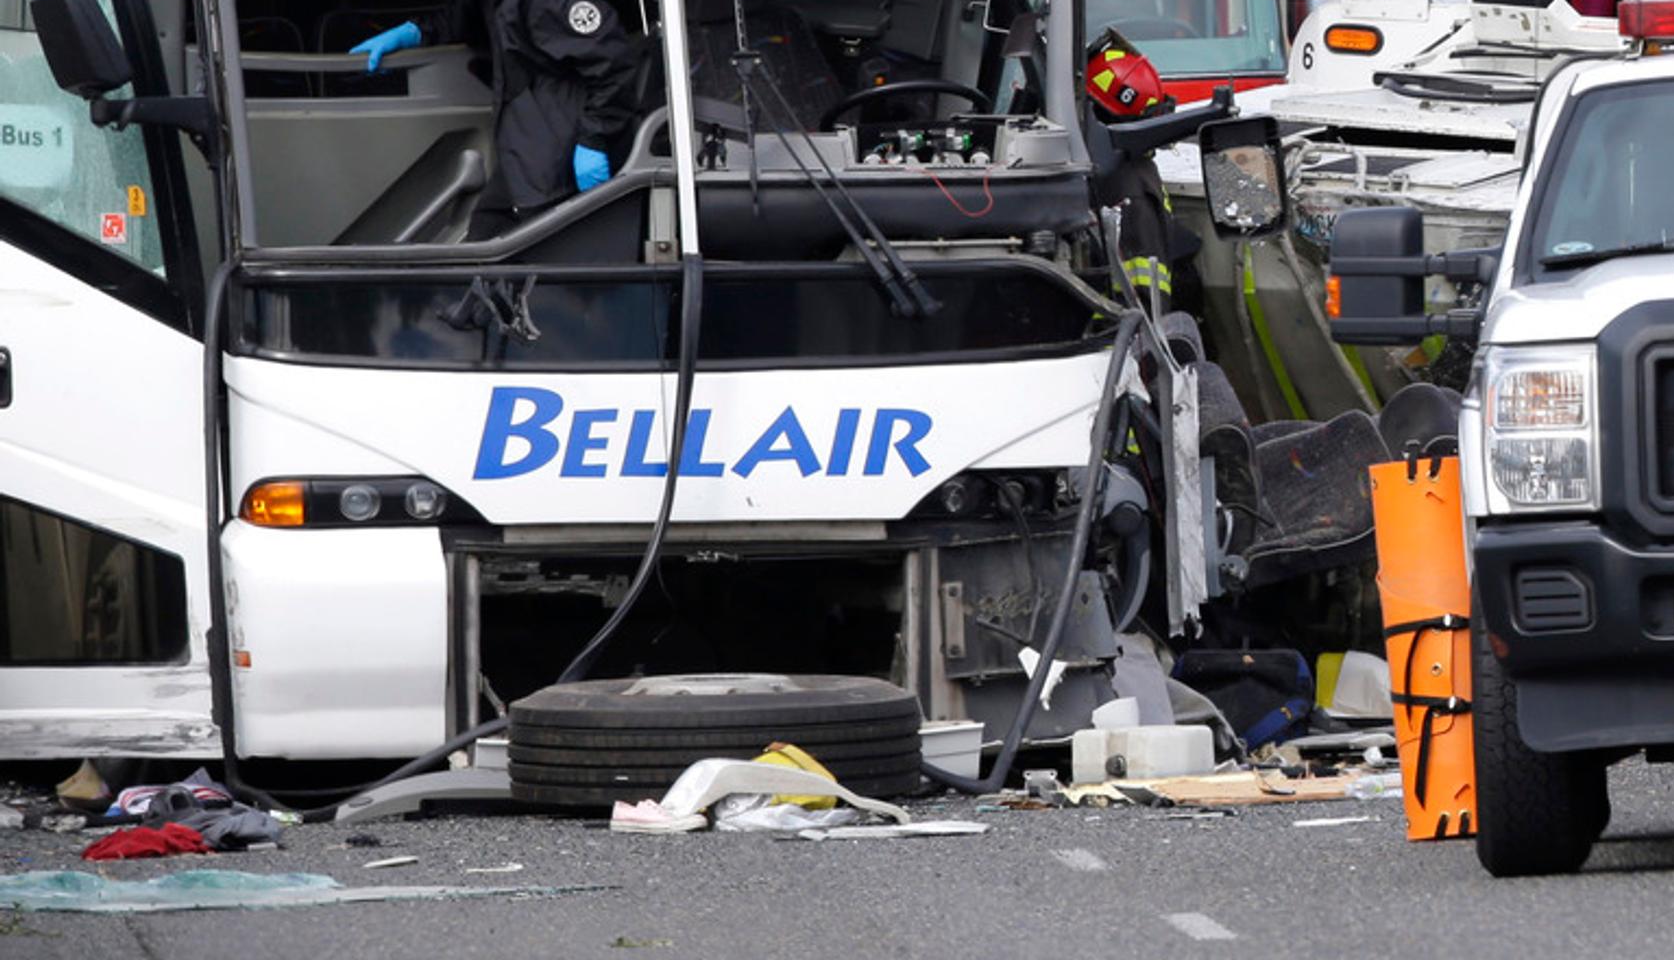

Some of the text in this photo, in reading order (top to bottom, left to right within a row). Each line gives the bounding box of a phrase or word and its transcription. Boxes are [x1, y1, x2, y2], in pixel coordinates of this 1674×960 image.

[1302, 42, 1315, 70] 6
[1120, 86, 1136, 104] 6
[51, 126, 62, 147] 1
